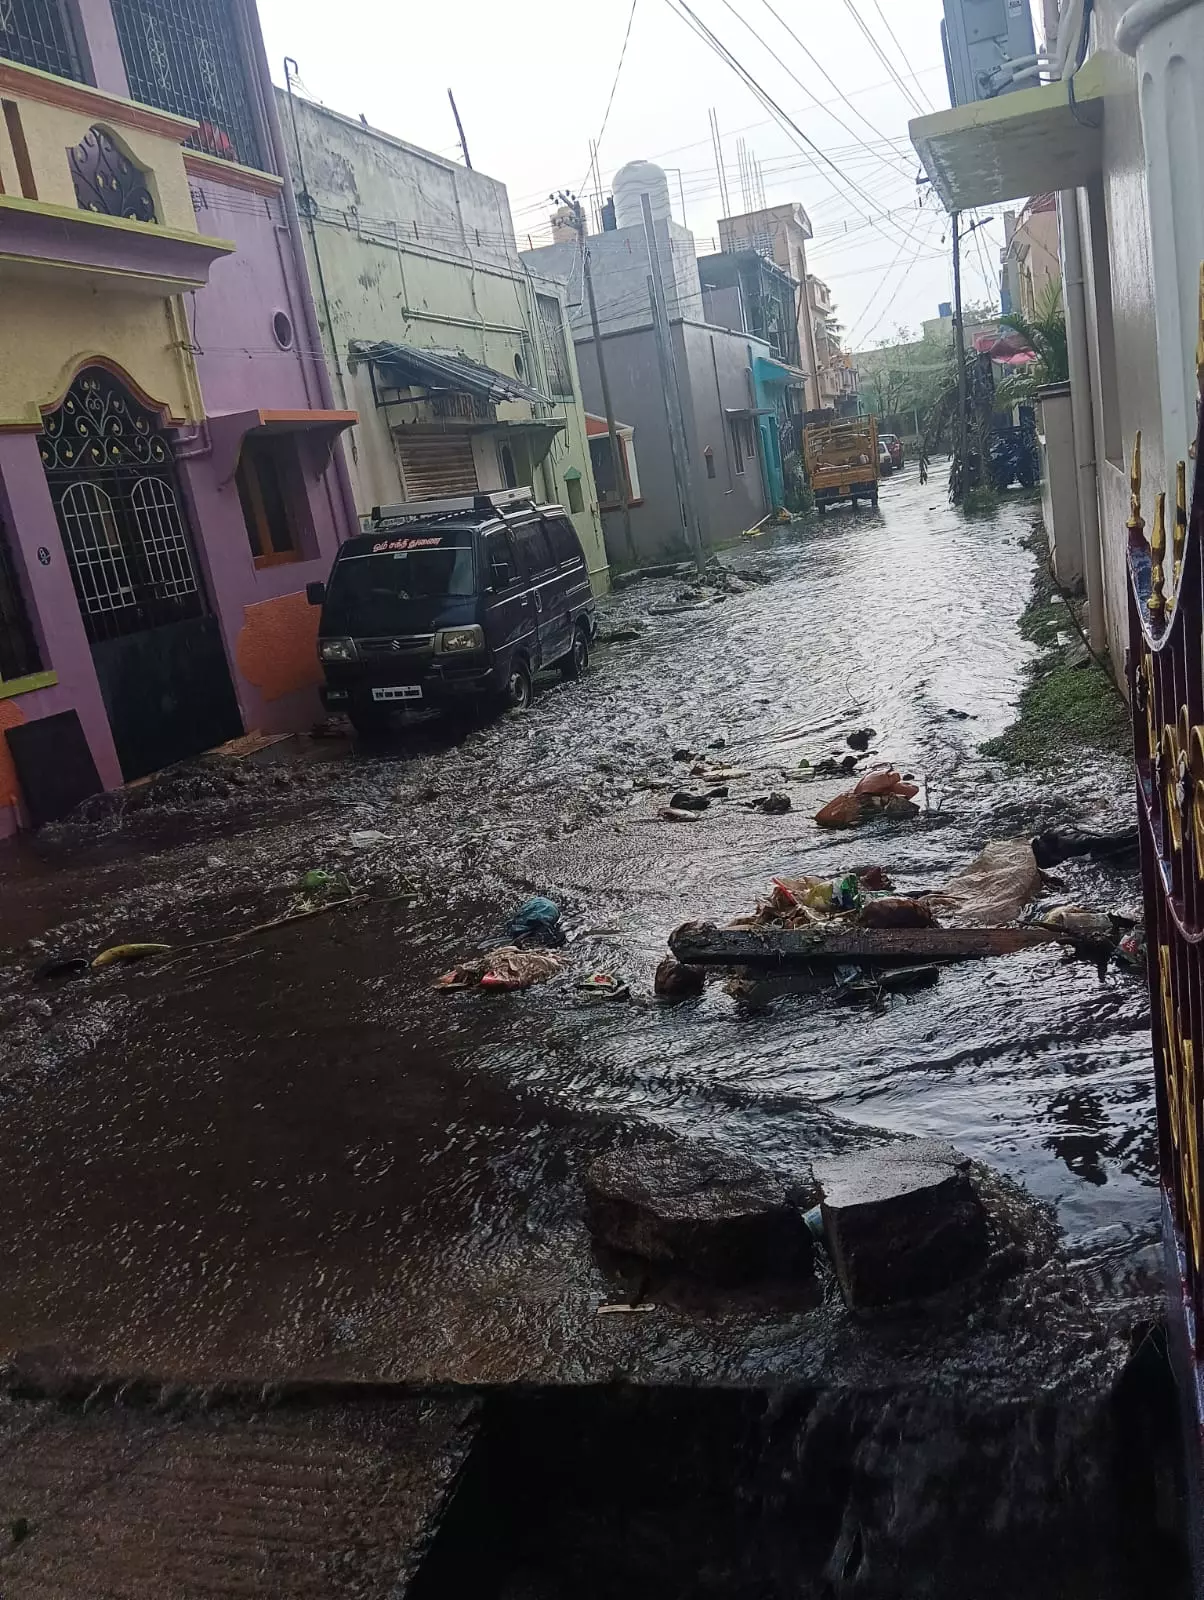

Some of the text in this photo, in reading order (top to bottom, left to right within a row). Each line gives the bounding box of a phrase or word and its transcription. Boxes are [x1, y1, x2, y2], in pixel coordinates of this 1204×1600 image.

[373, 537, 443, 552] ஓம் சக்தி துணை
